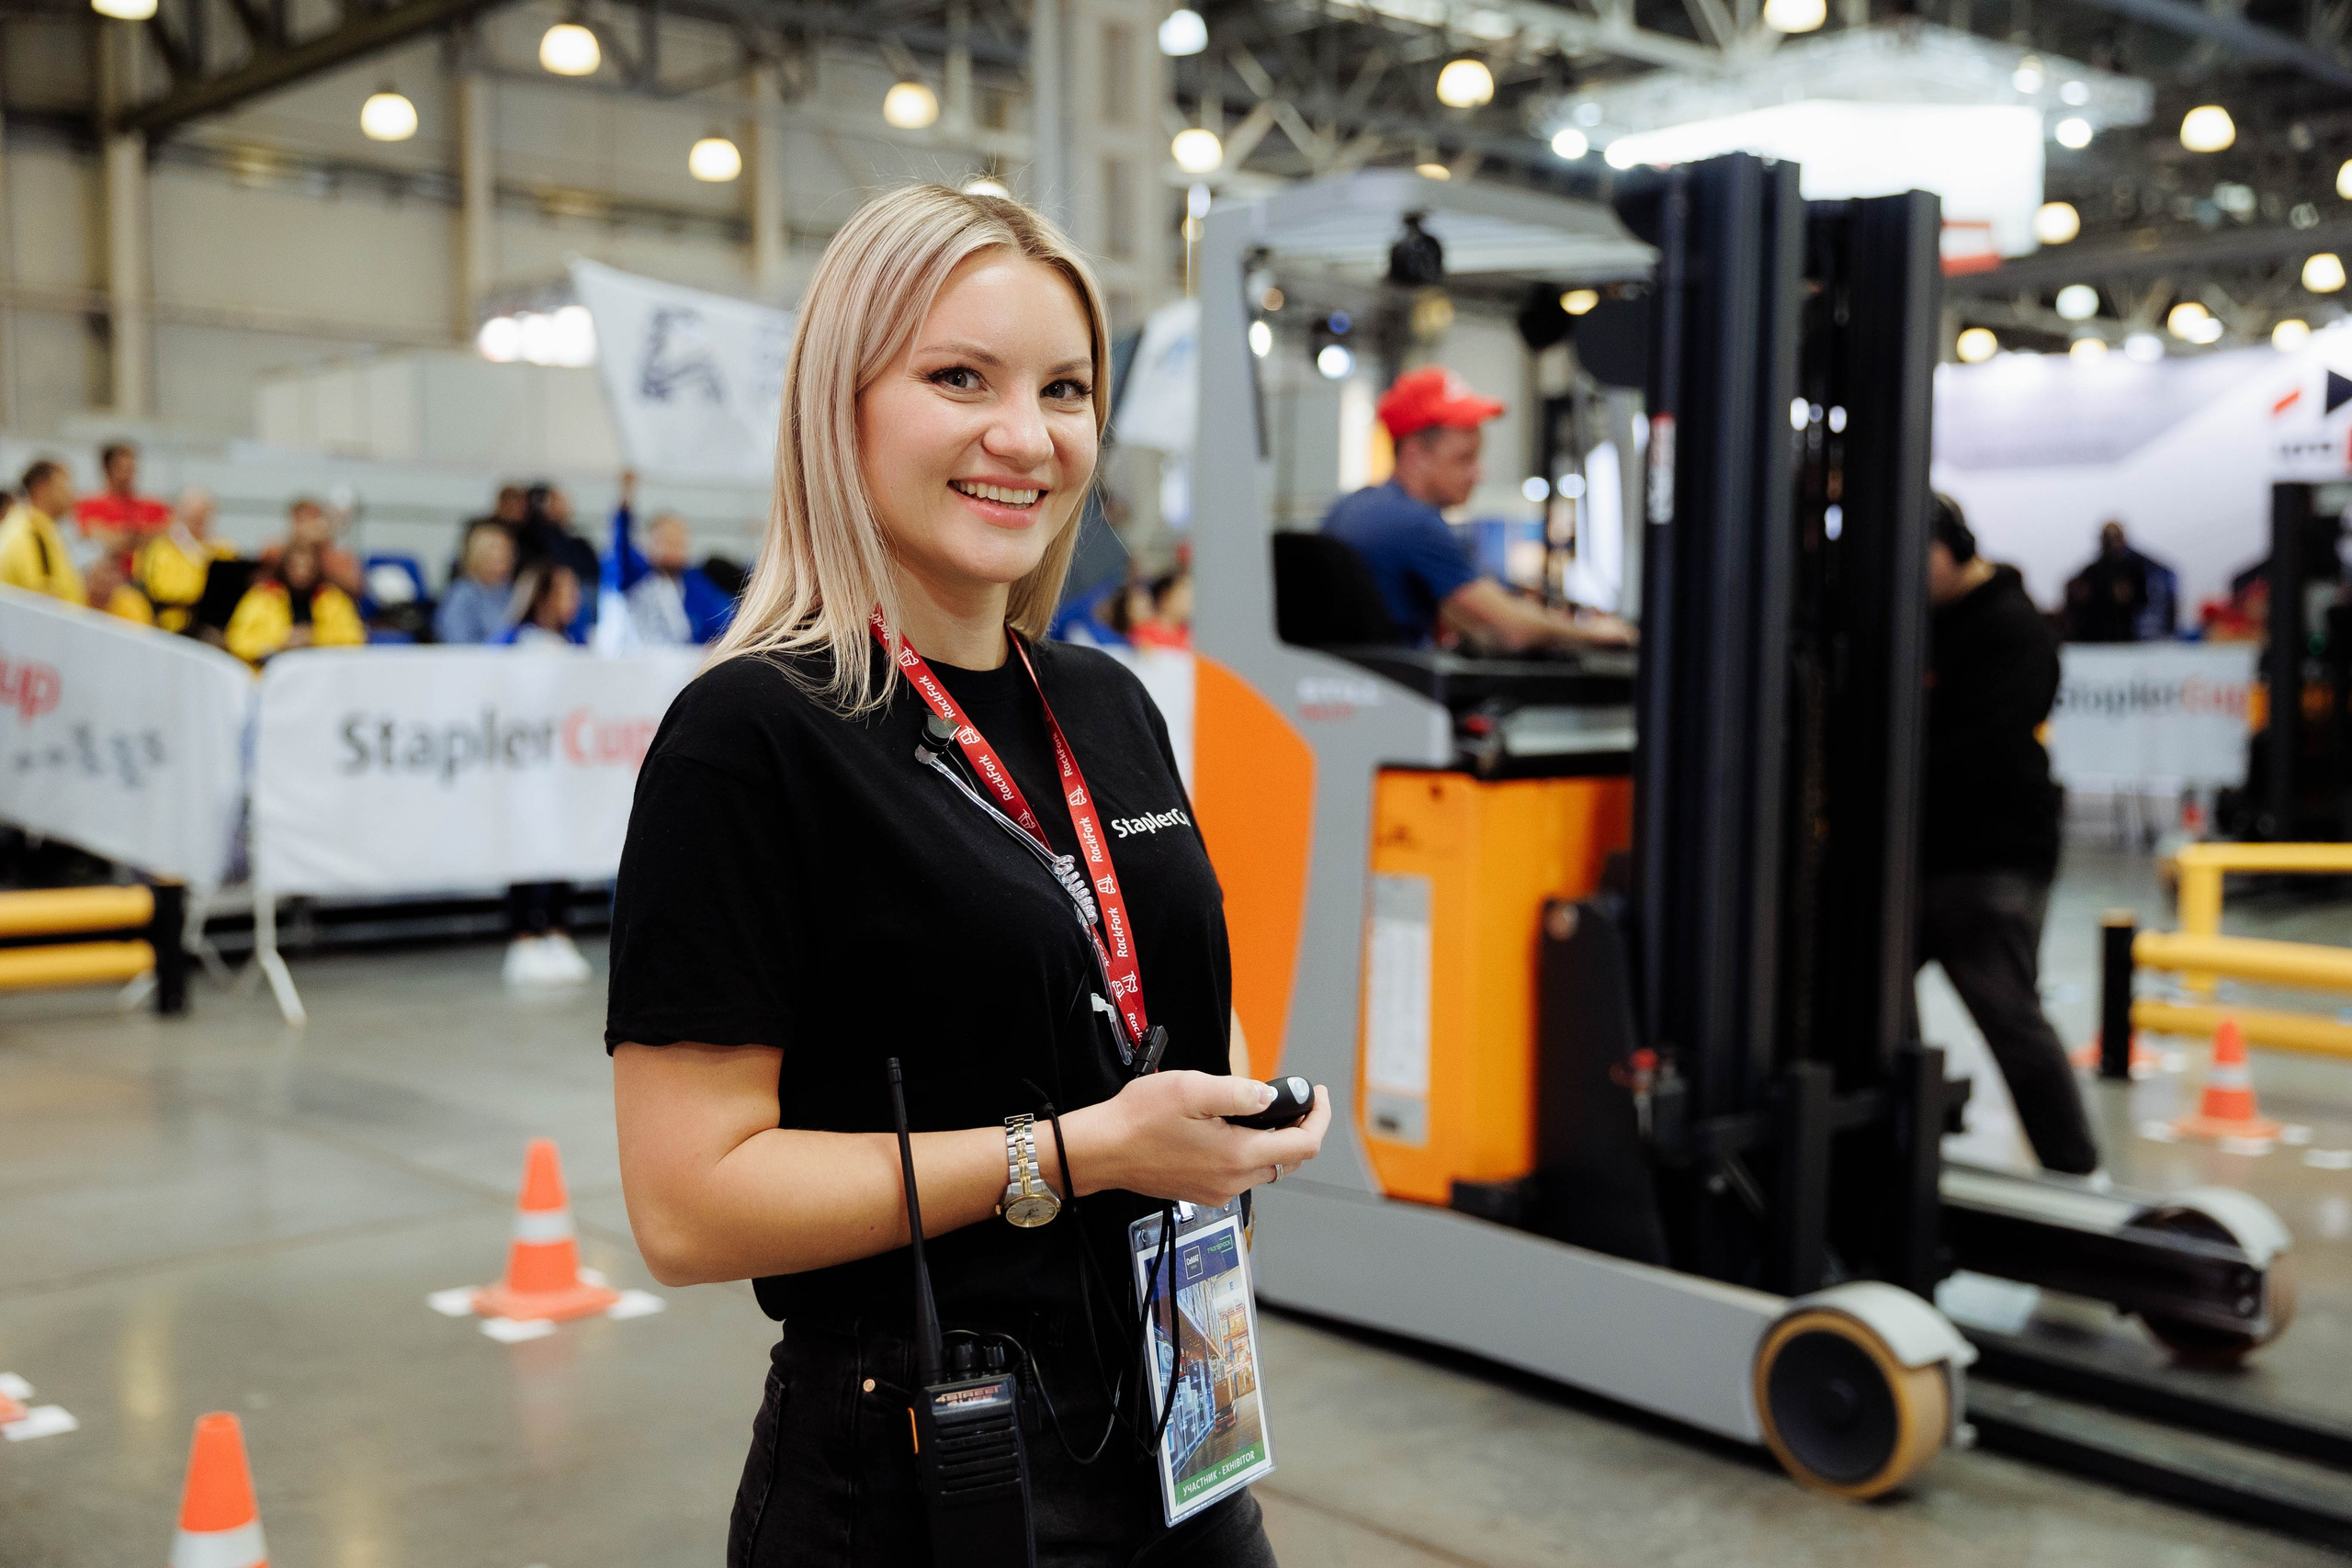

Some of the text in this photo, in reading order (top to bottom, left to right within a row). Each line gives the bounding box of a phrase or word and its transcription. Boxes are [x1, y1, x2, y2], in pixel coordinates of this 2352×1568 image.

[919, 675, 956, 718] RackFork
[978, 753, 1015, 801] RackFork
[1053, 732, 1073, 778] RackFork
[1079, 816, 1103, 863] RackFork
[1106, 907, 1129, 957] RackFork
[1126, 1012, 1144, 1042] Rack
[1182, 1450, 1255, 1496] УЧАСТНИК EXHIBITOR
